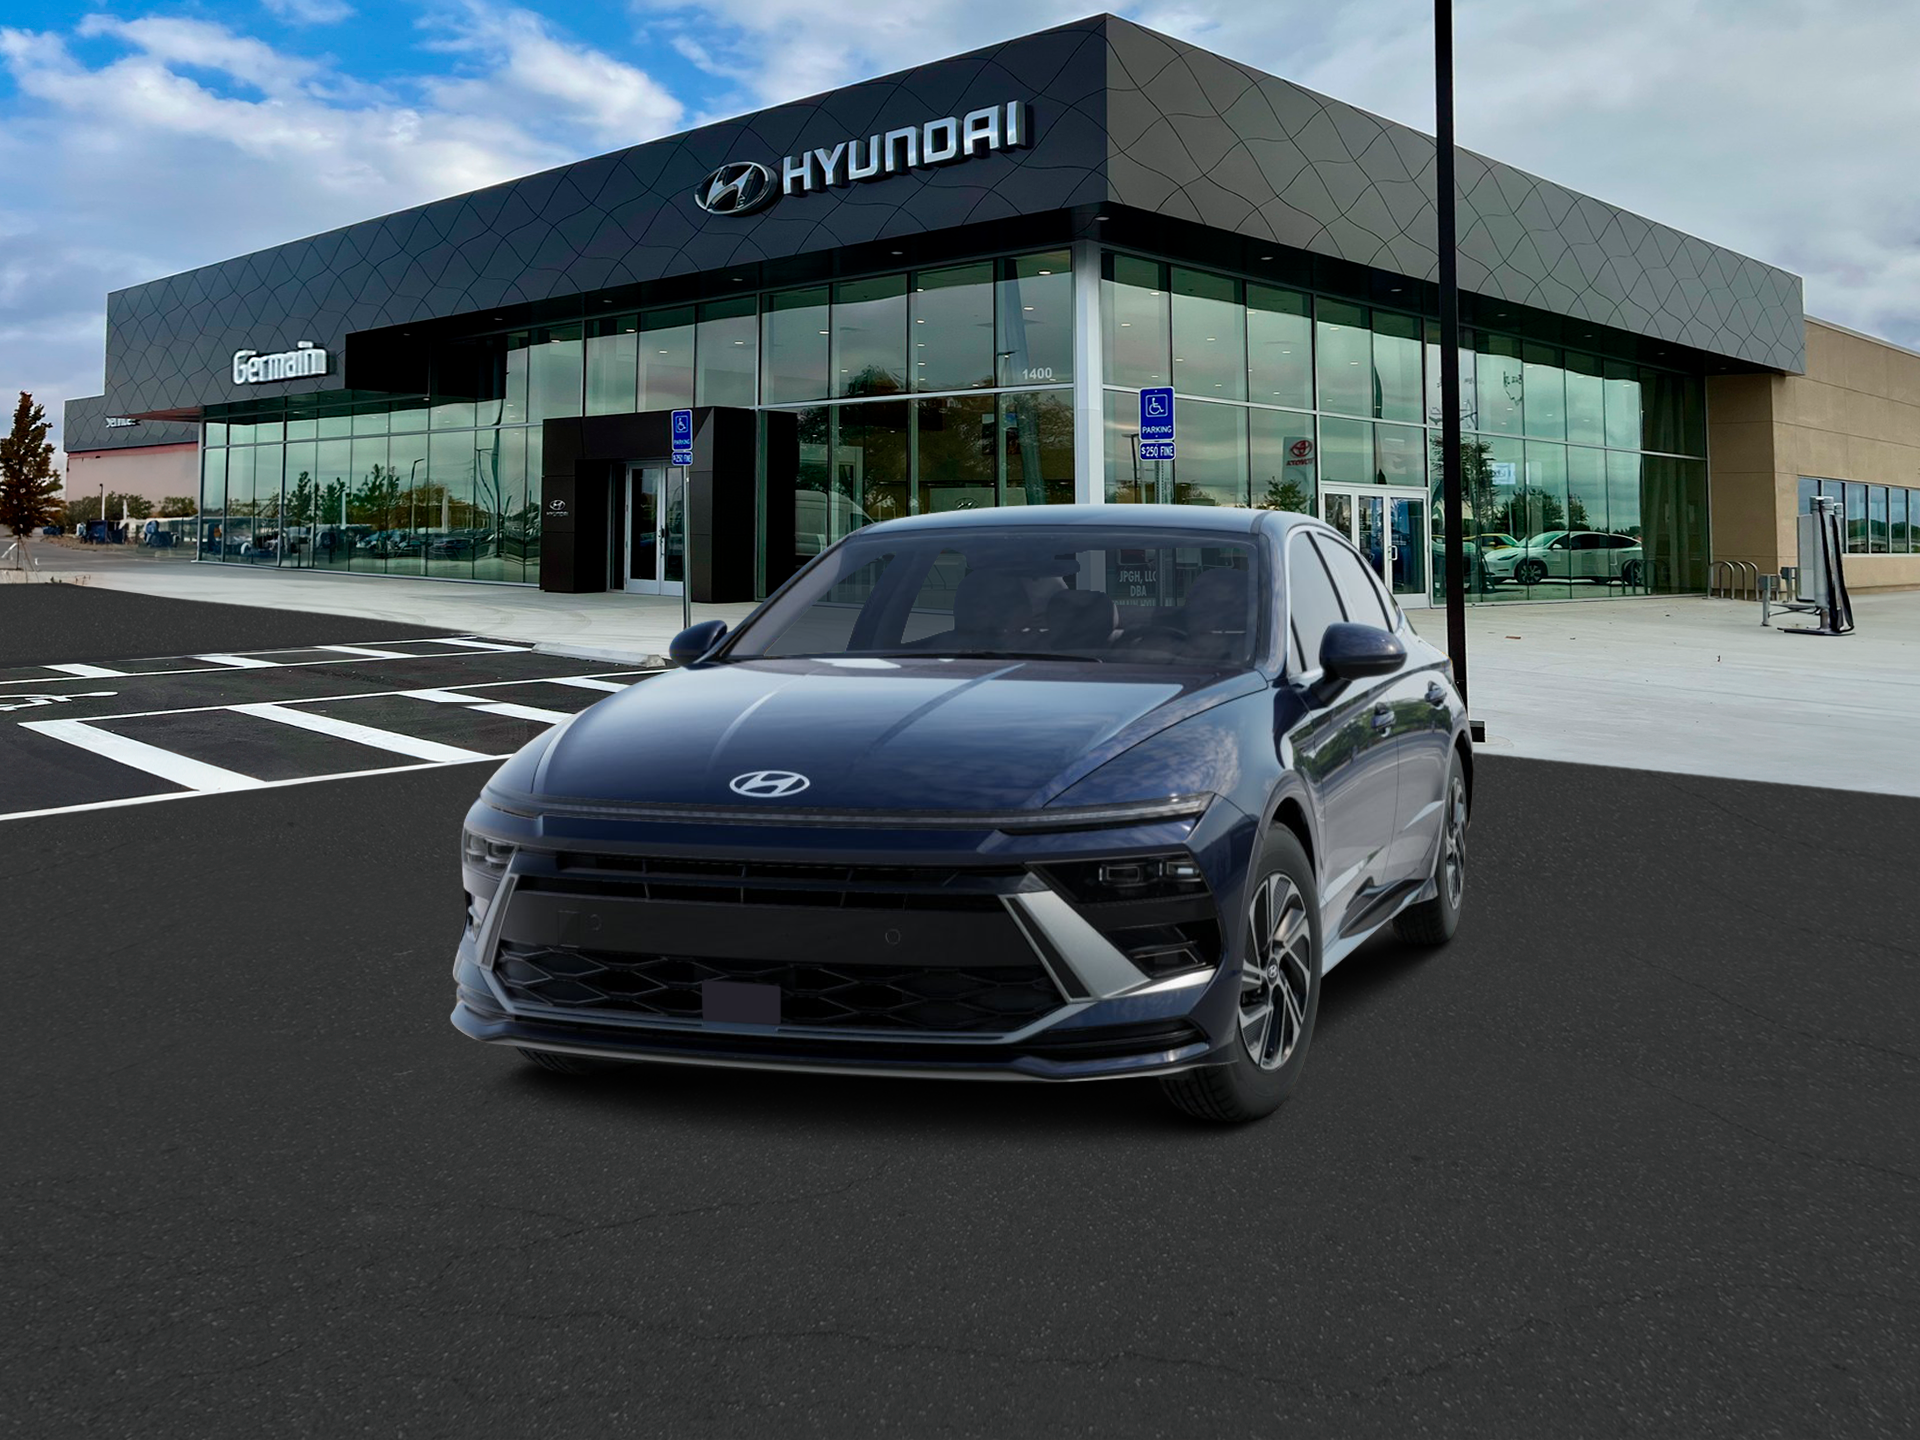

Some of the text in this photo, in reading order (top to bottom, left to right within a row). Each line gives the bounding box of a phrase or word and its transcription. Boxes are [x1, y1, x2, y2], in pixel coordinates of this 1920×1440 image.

[783, 100, 1023, 194] HYUNDAI
[233, 341, 327, 384] Germain
[1022, 367, 1052, 379] 1400
[1142, 425, 1172, 434] PARKING
[1141, 446, 1174, 457] $250 FINE
[1119, 570, 1143, 584] JPGH,
[1130, 585, 1147, 597] DBA
